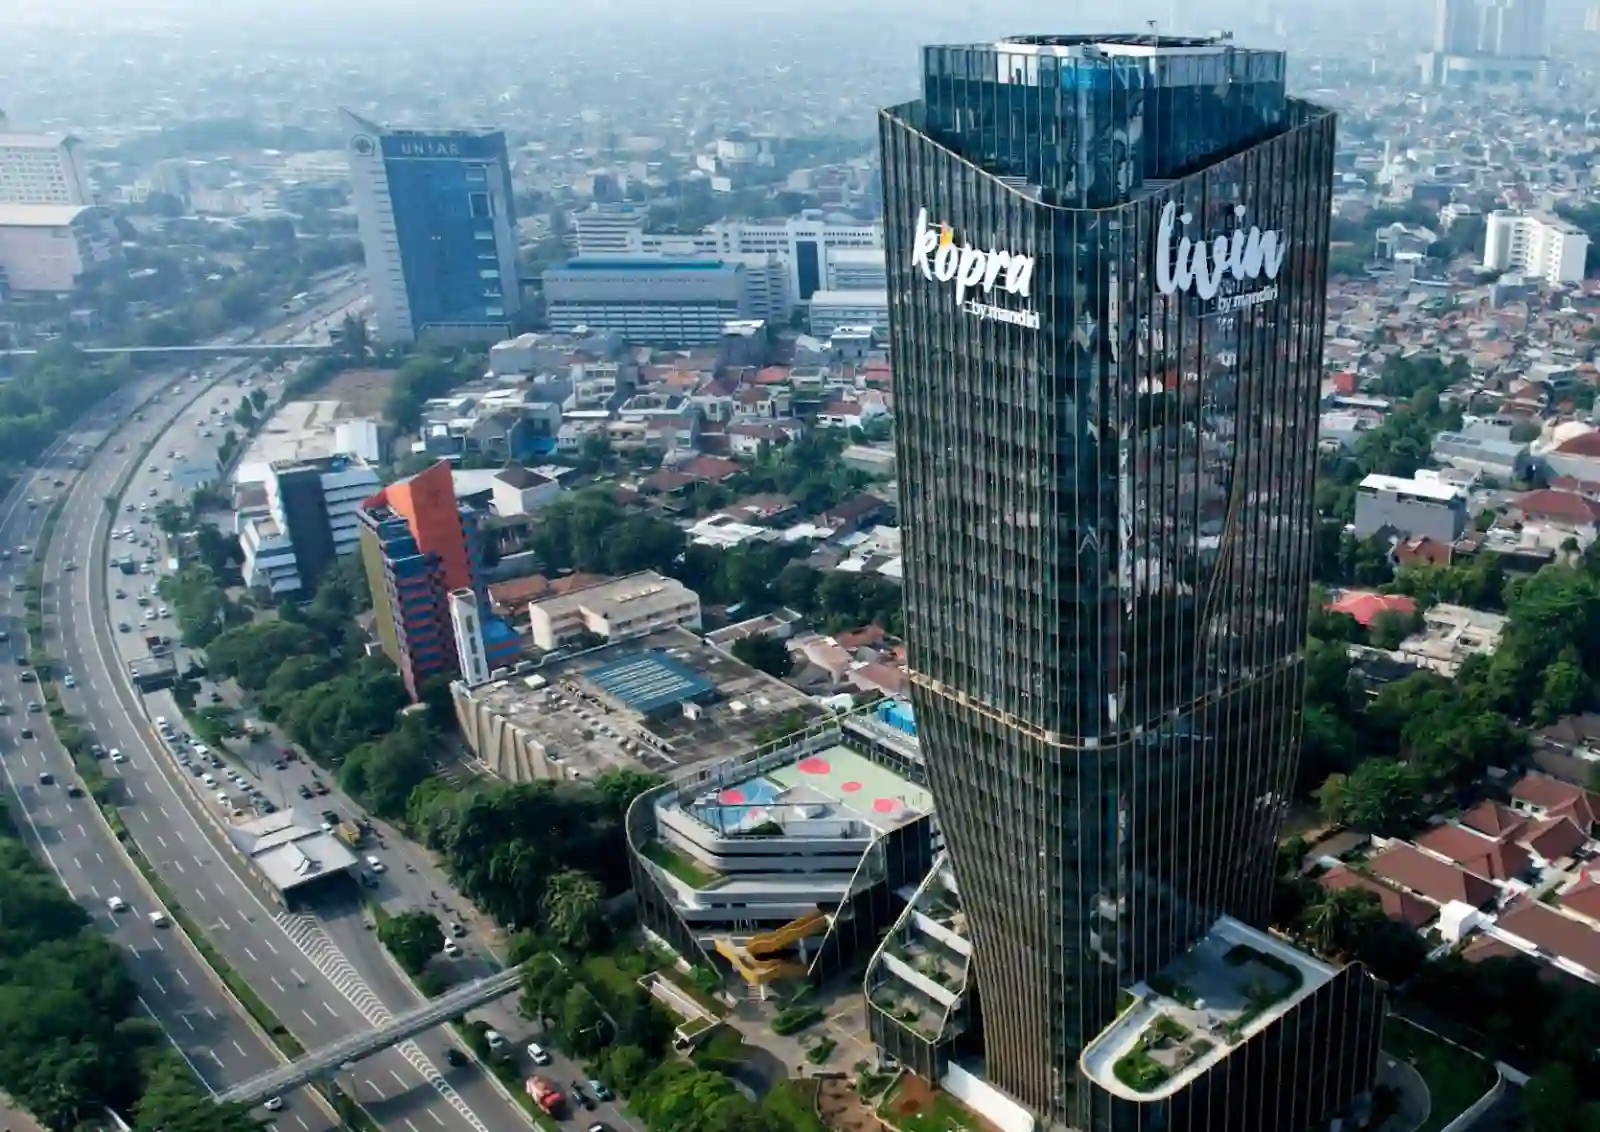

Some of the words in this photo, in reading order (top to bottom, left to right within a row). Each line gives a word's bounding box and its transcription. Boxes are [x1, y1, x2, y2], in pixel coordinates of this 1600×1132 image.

[912, 205, 1034, 305] kopra
[1156, 200, 1286, 300] livin
[972, 298, 985, 320] by
[1218, 296, 1232, 314] by
